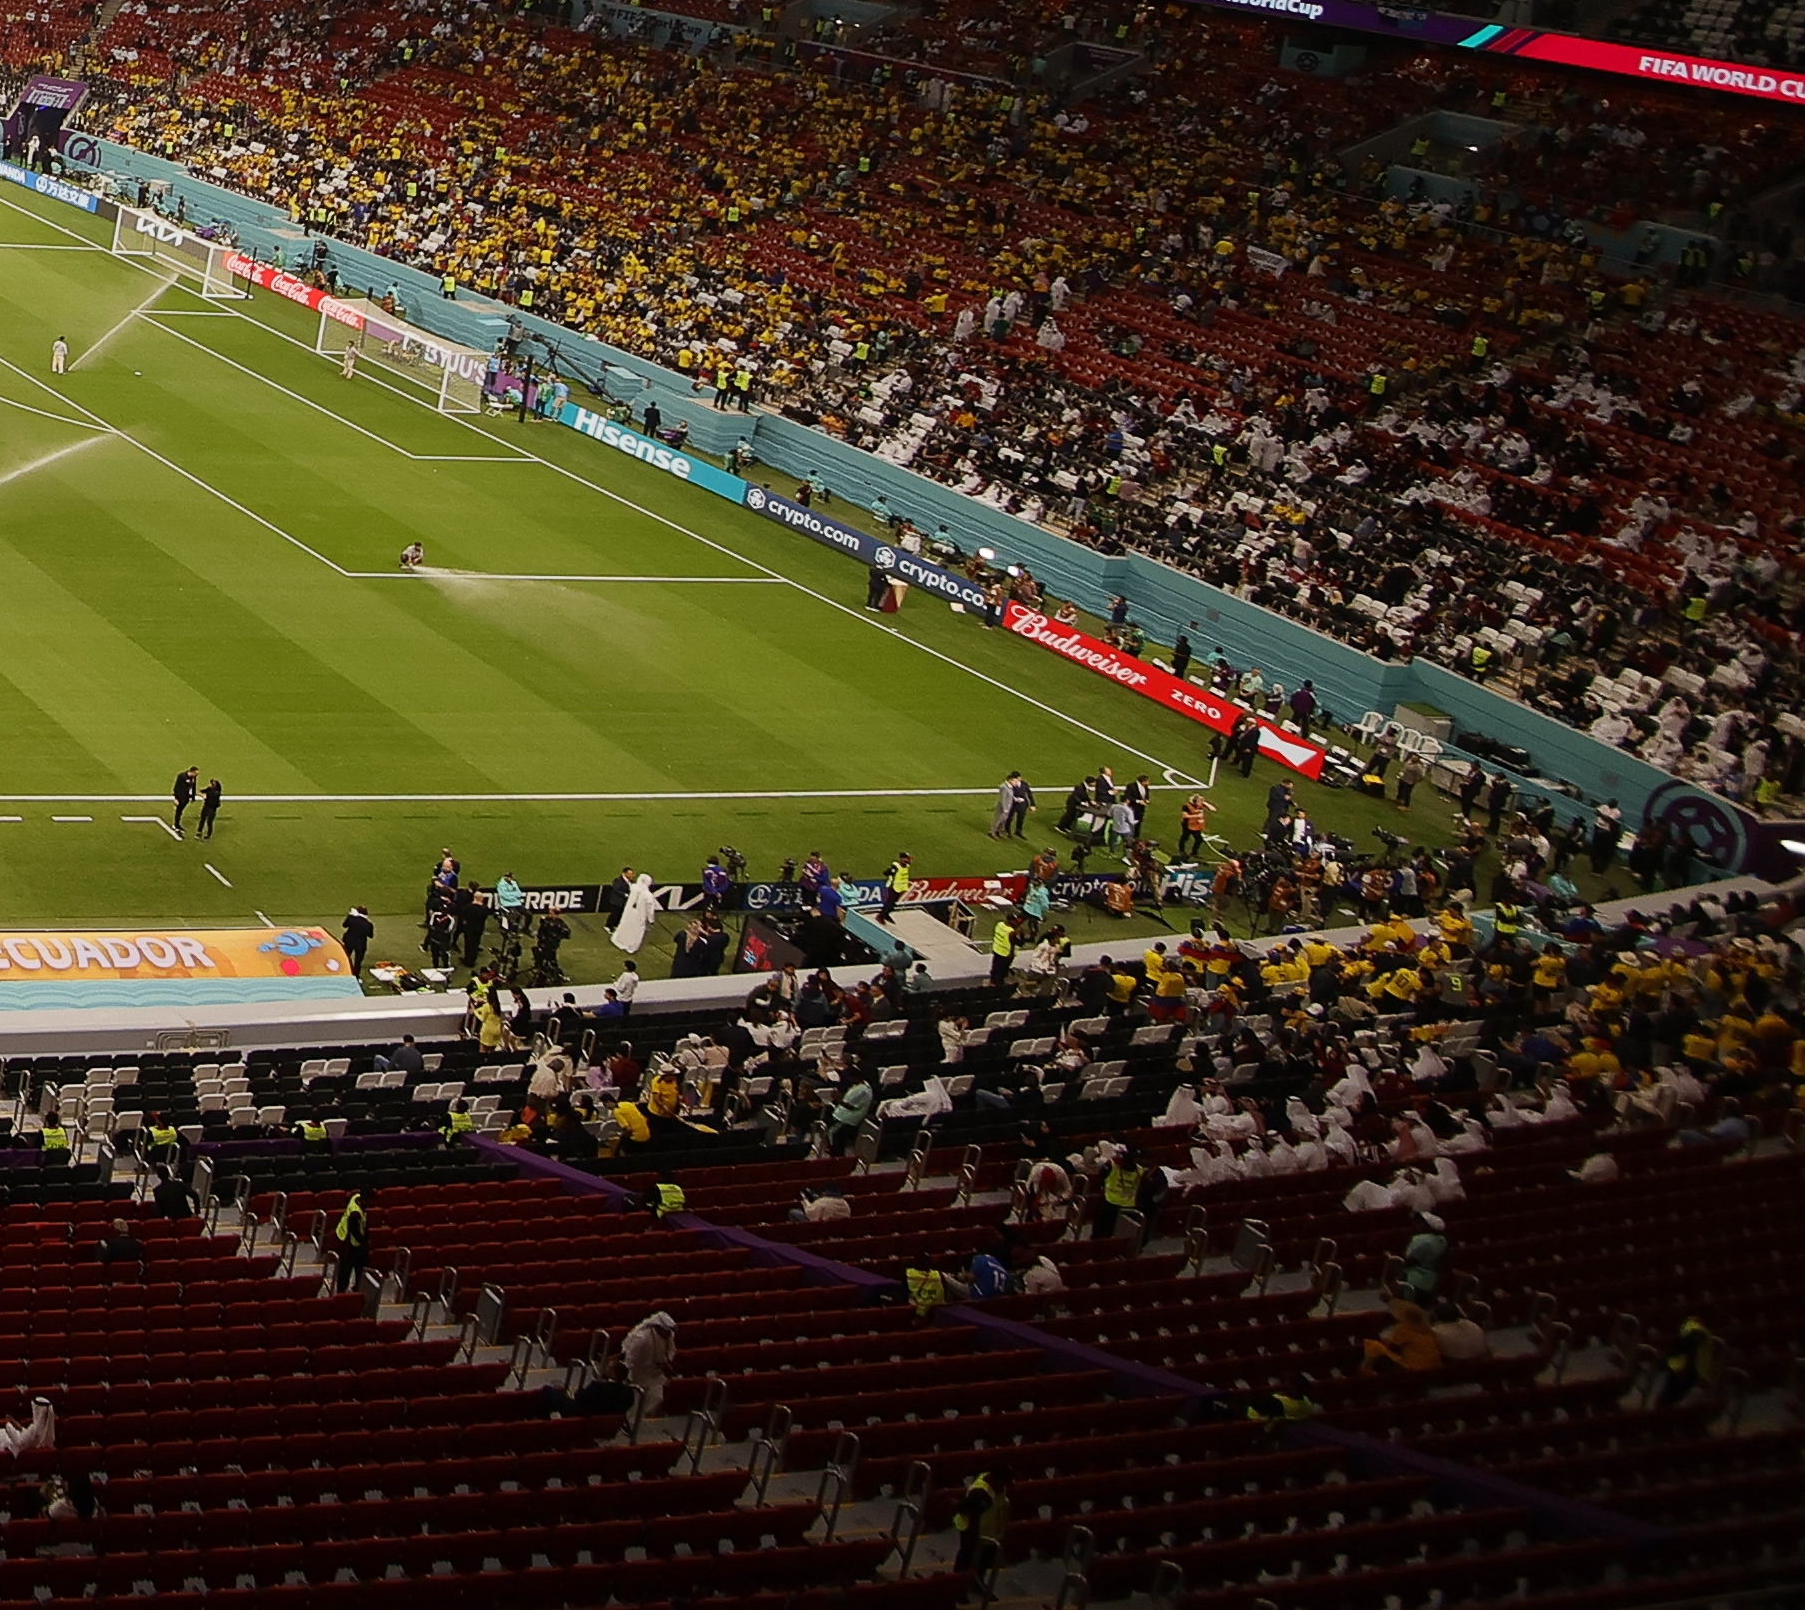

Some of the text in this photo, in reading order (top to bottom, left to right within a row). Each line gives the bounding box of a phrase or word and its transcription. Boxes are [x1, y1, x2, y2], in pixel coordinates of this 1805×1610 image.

[1638, 55, 1690, 80] FIFA
[1691, 63, 1777, 92] WORLD
[270, 274, 311, 307] Coca-Cola
[574, 407, 691, 480] Hisense
[768, 497, 860, 552] crypto.com
[1011, 605, 1222, 720] Budweiser ZERO
